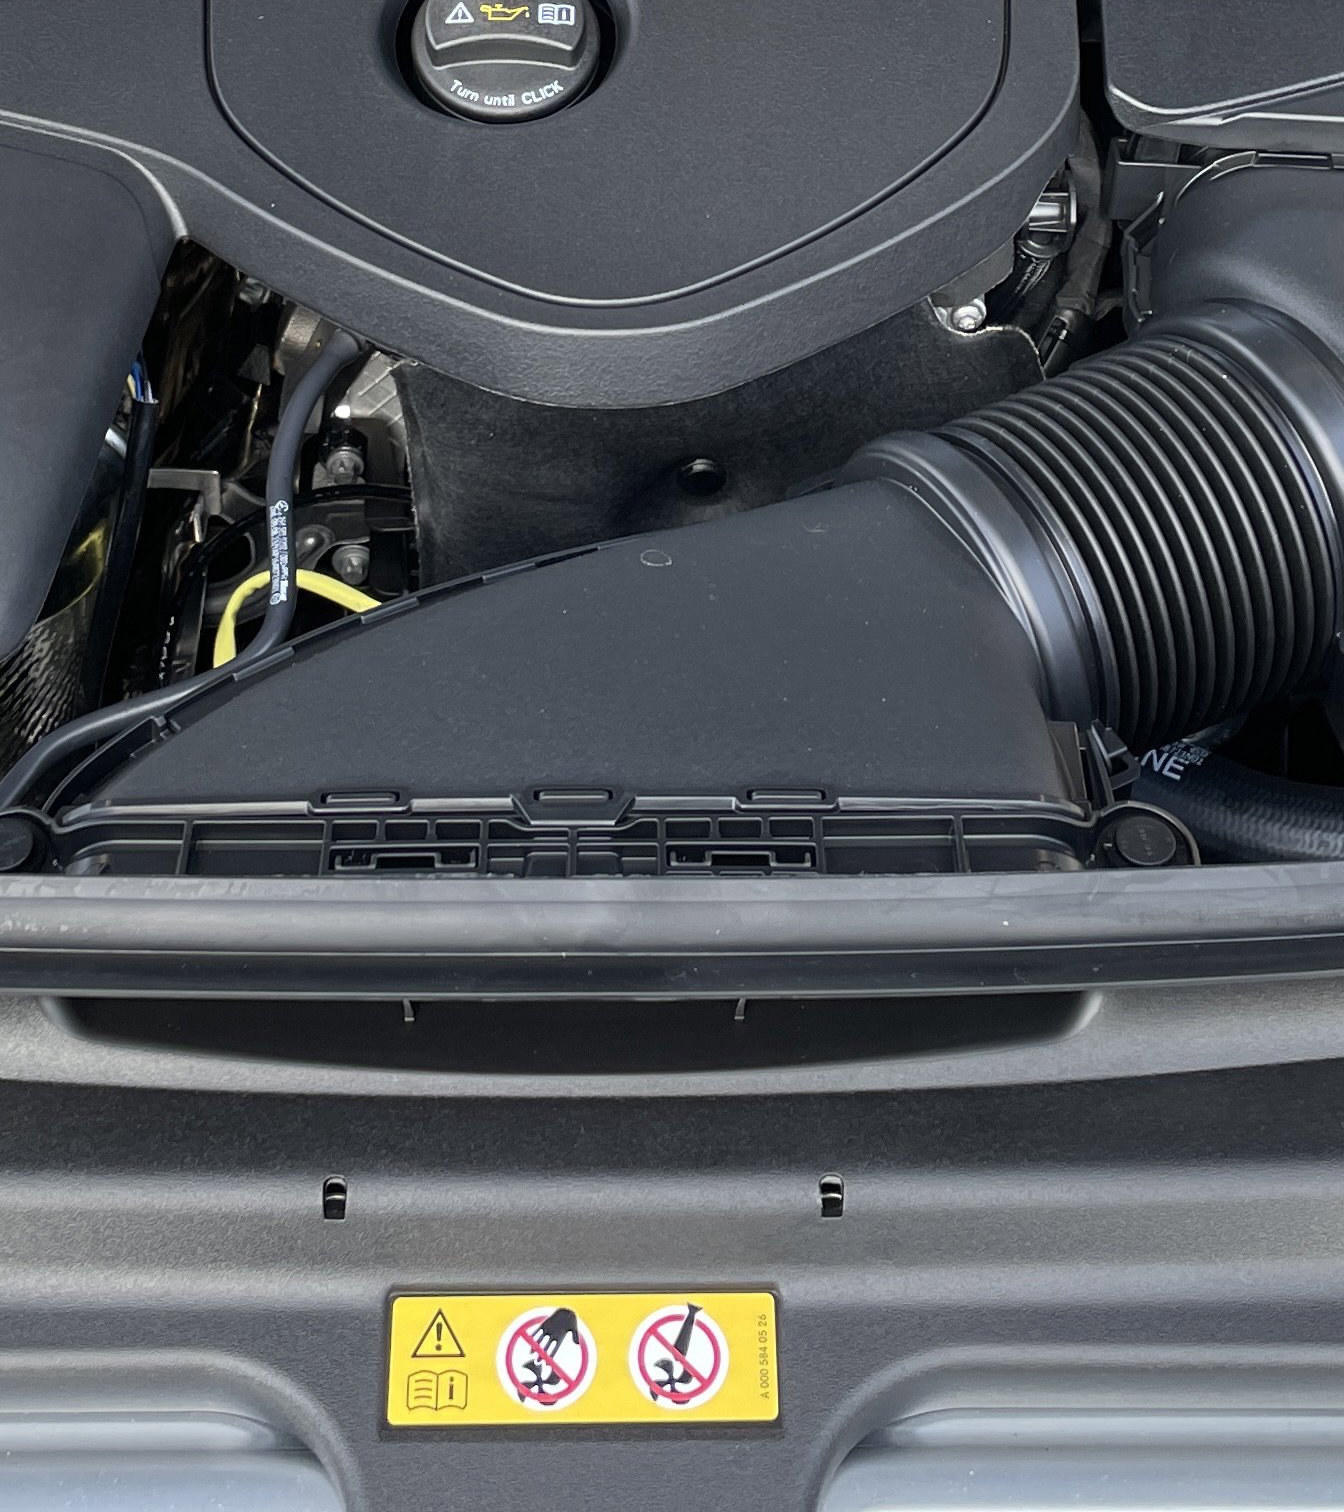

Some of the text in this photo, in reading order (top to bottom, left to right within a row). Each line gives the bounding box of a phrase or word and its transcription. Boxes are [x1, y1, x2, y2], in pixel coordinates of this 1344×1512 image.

[450, 79, 564, 106] Turn until CLICK
[758, 1313, 769, 1399] A 000 584 05 26
